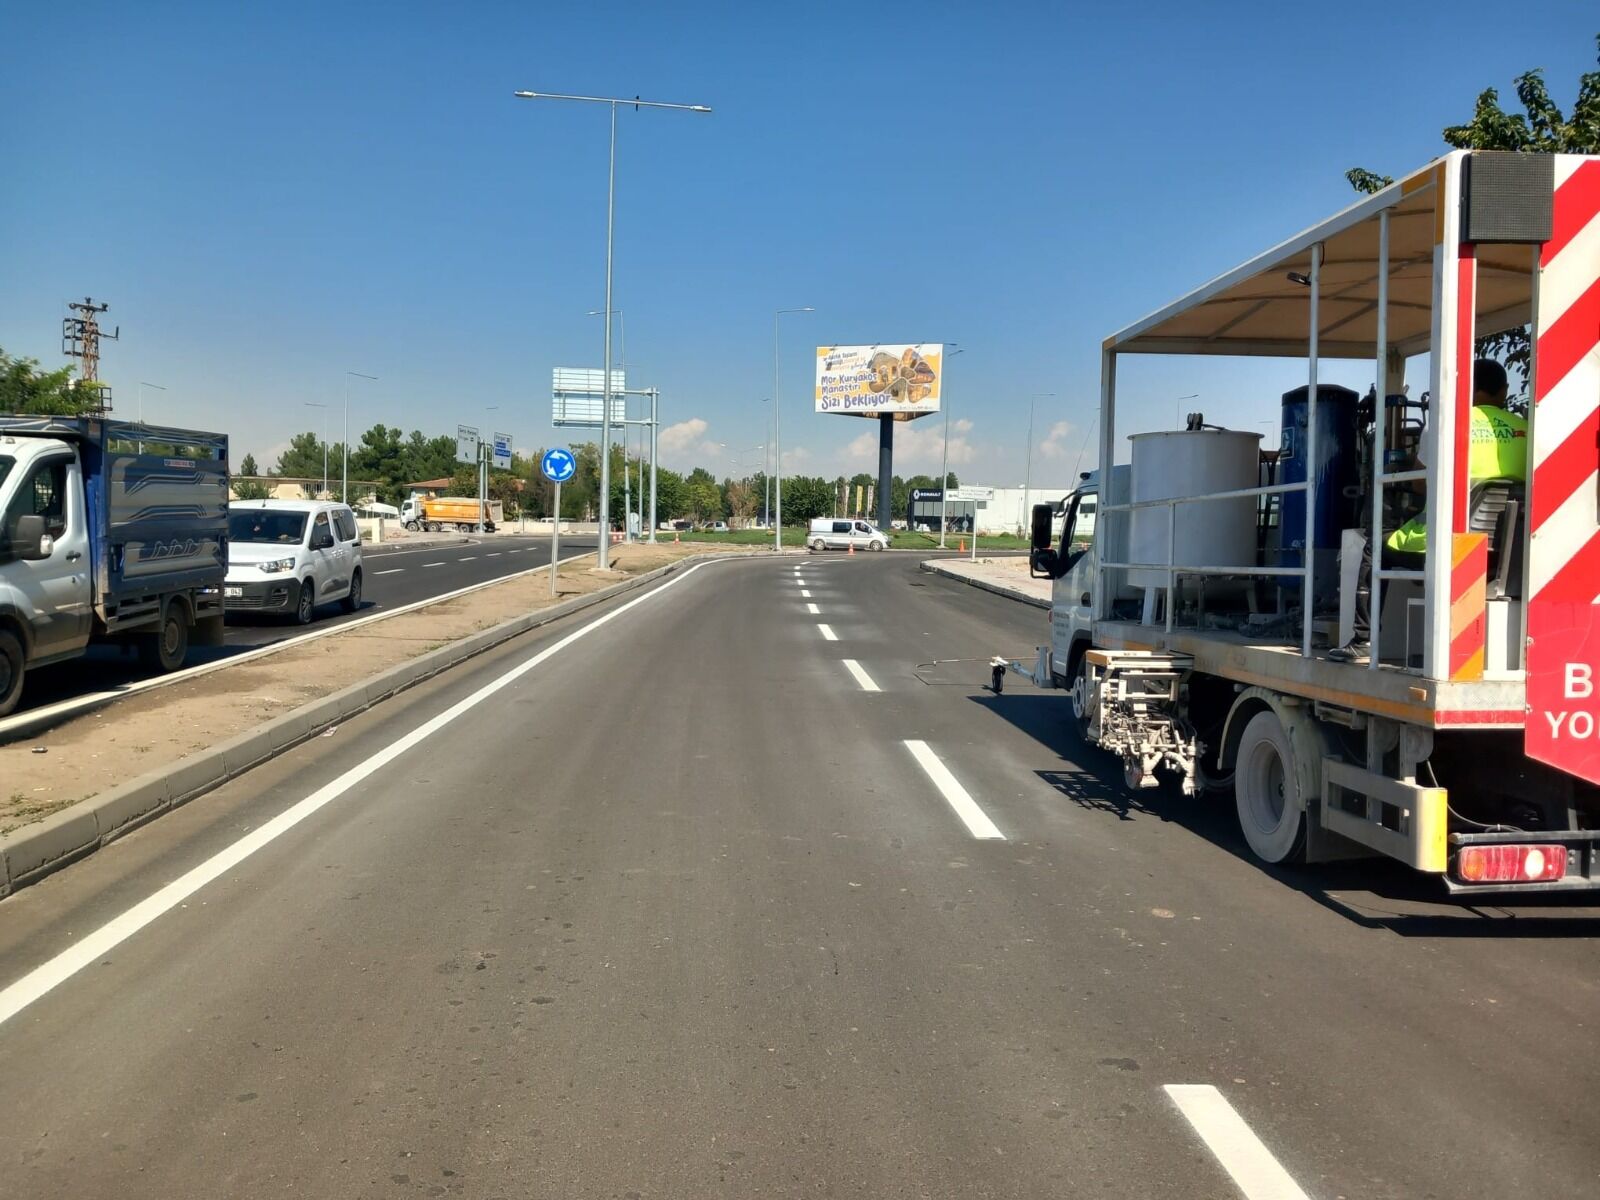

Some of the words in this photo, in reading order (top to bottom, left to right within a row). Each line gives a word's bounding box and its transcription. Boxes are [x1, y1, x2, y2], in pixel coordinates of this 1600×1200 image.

[821, 375, 837, 385] Mor
[839, 373, 877, 384] Kuryakos
[821, 395, 840, 410] Sizi
[844, 393, 891, 409] Bekliyor
[1471, 428, 1515, 438] ATMAN
[1564, 662, 1595, 698] B
[1543, 710, 1600, 740] YO
